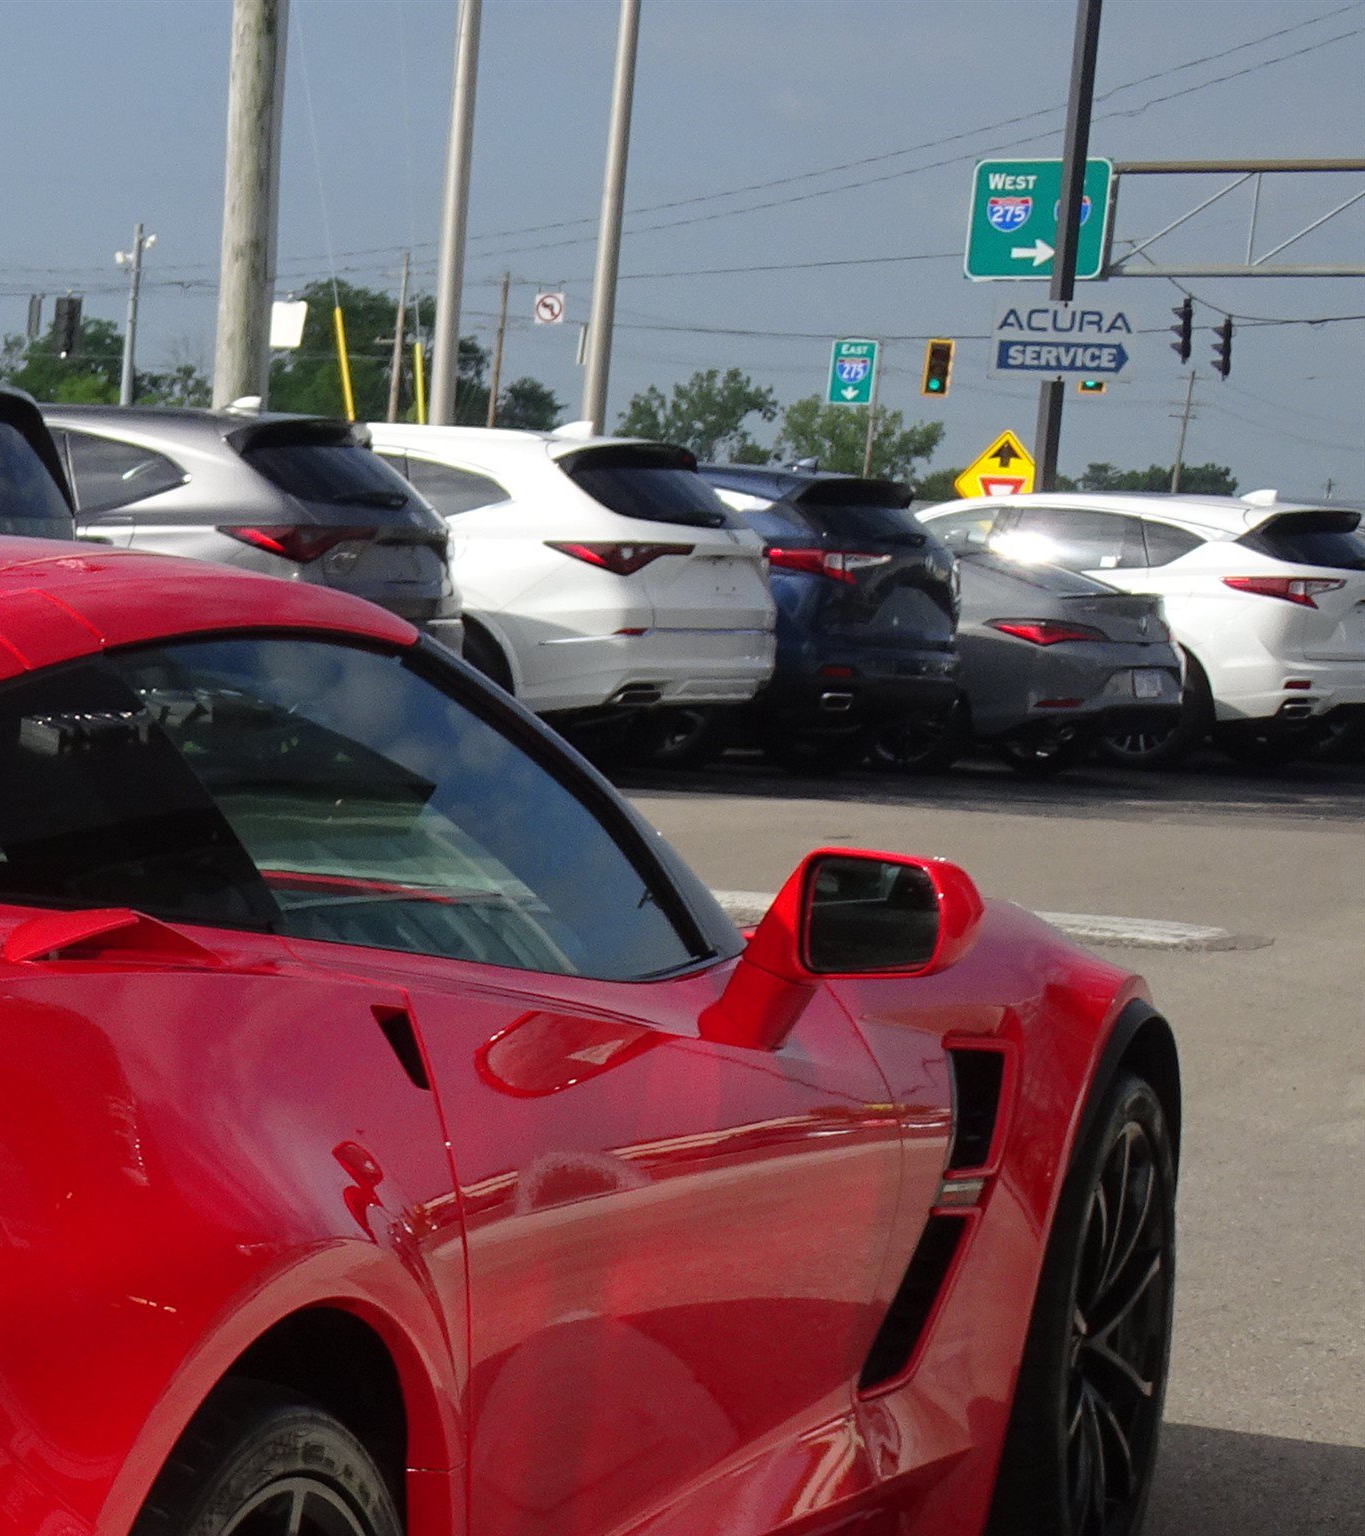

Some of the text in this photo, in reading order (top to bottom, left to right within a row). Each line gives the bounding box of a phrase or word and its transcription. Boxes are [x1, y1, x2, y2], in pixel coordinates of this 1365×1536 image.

[988, 173, 1037, 190] WEST
[991, 206, 1026, 222] 275
[997, 308, 1132, 334] ACURA
[841, 343, 869, 355] EAST
[1008, 345, 1117, 368] SERVICE
[842, 364, 865, 379] 275
